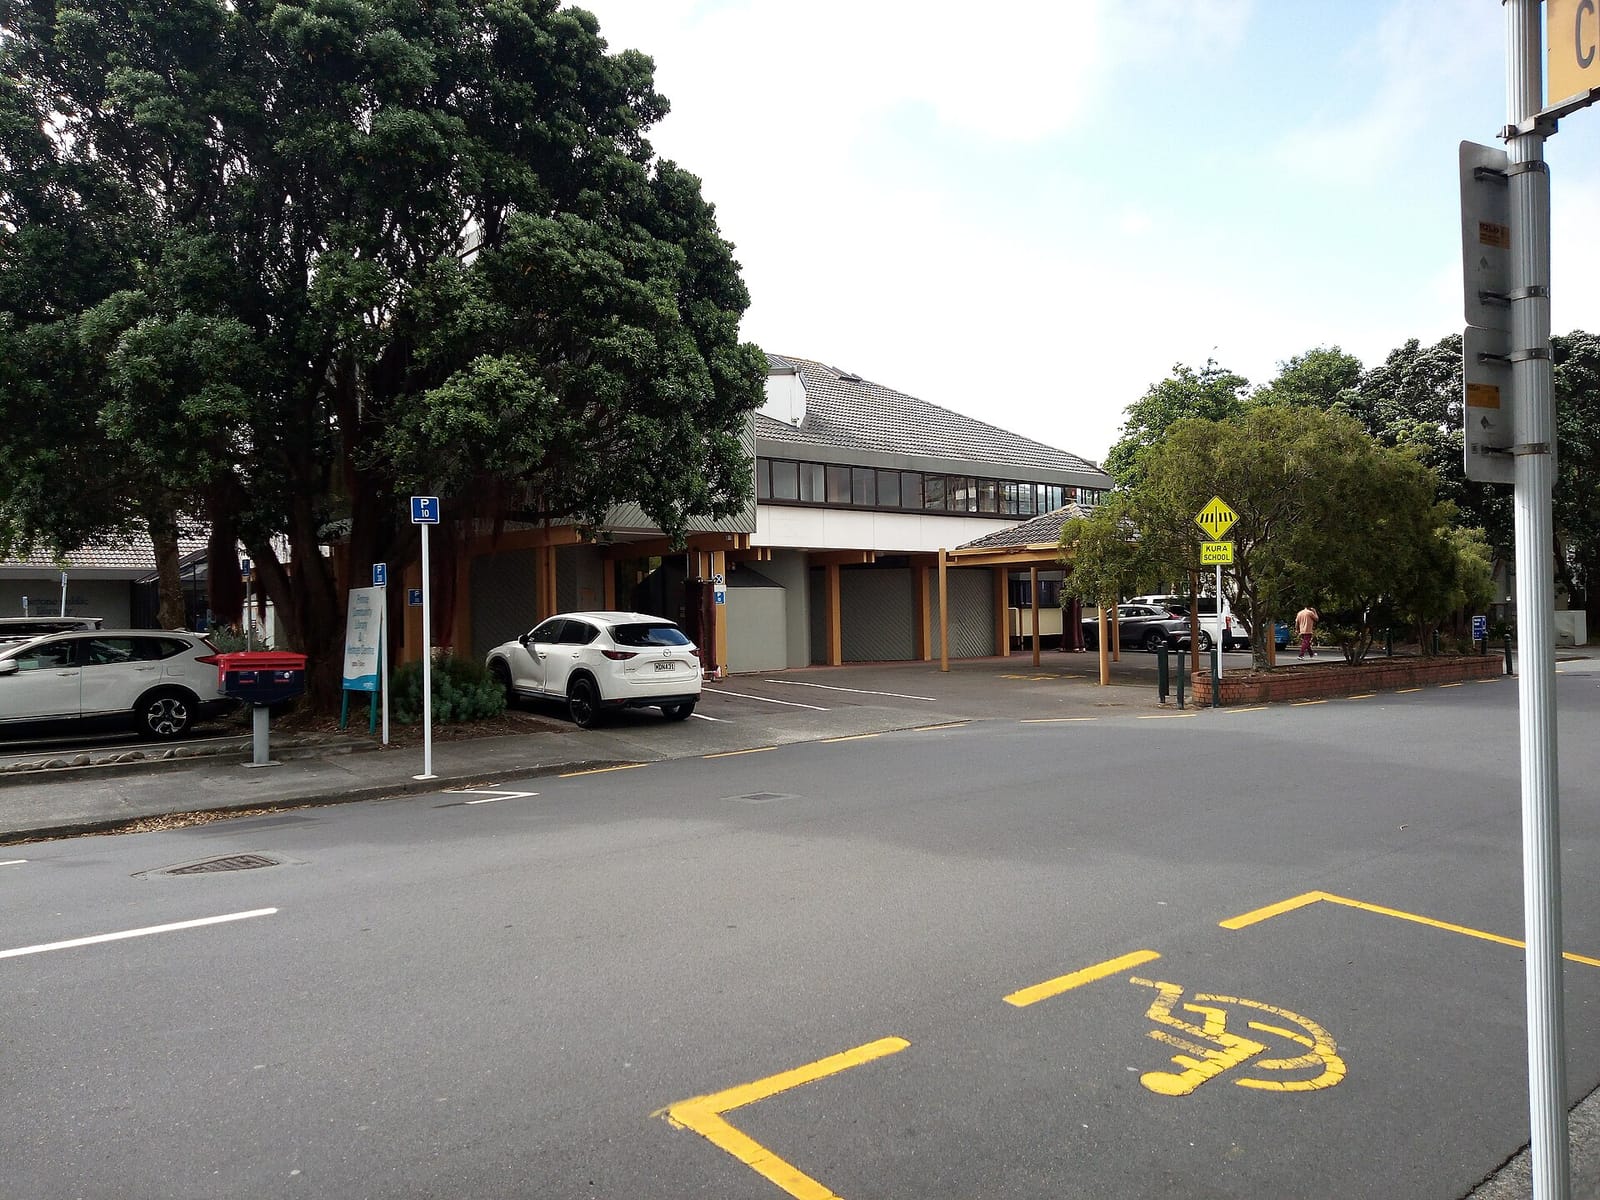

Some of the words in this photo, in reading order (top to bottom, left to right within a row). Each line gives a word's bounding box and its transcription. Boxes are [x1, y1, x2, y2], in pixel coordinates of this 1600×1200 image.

[1575, 0, 1600, 69] C
[420, 498, 430, 509] P
[421, 509, 430, 518] 10
[1203, 553, 1230, 561] SCHOOL
[376, 565, 382, 574] P
